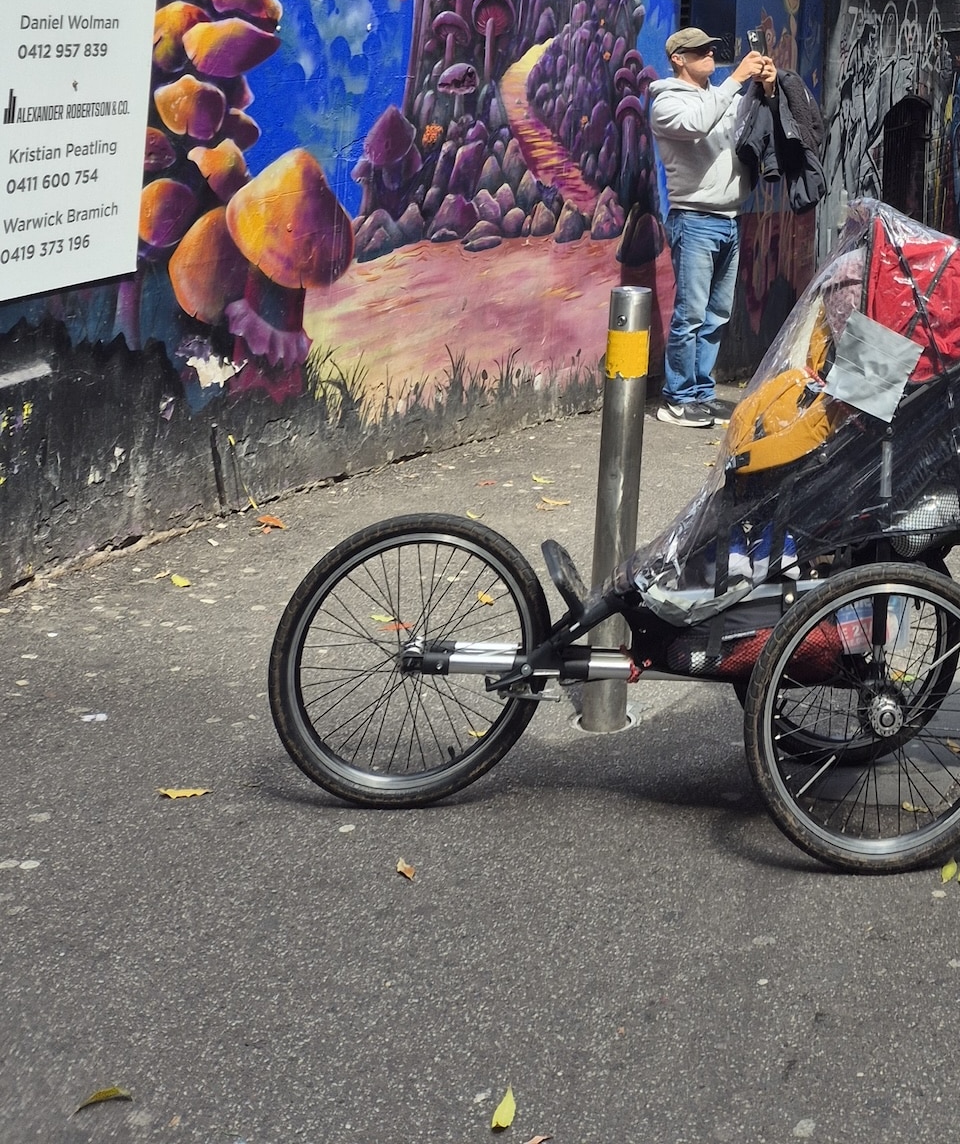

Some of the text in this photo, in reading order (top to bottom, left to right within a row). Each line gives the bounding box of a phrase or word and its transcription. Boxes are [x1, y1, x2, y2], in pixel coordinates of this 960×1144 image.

[20, 15, 120, 30] Daniel Wolman
[17, 43, 108, 60] 0412 957 839
[16, 104, 64, 124] ALEXANDER
[65, 101, 111, 119] ROBERTSON
[8, 139, 118, 164] Kristian Peatling
[6, 168, 99, 194] 0411 600 754
[3, 202, 119, 234] Warwick Bramich
[0, 234, 90, 265] 0419 373 196
